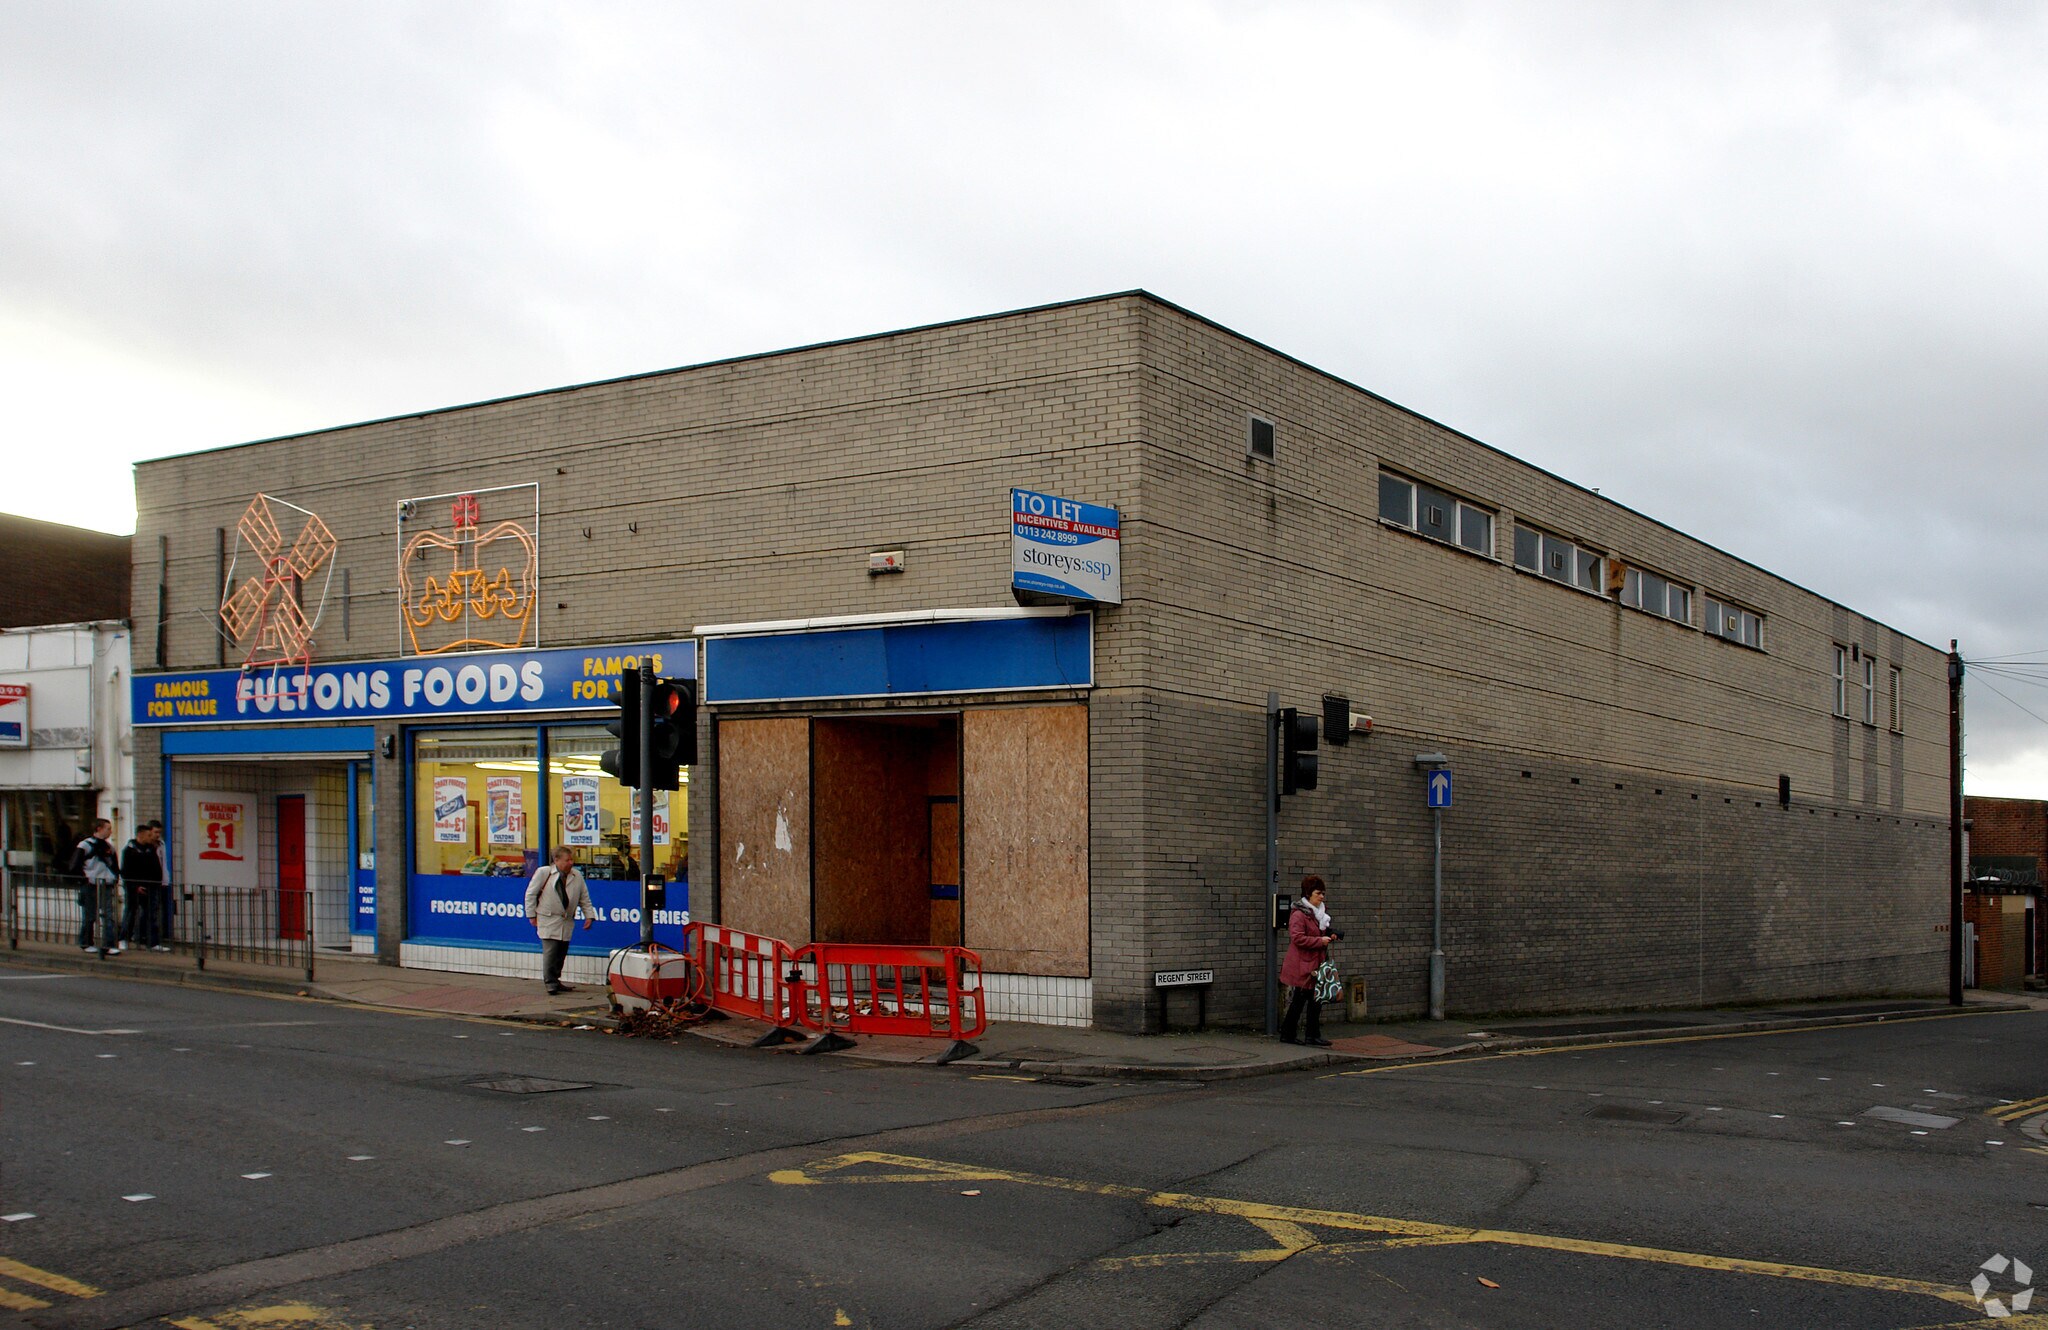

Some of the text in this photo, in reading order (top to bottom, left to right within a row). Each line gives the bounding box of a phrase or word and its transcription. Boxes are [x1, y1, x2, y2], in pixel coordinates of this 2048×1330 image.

[1018, 493, 1082, 523] TO LET
[1016, 513, 1117, 538] INCENTIVES AVAILABLE
[1018, 525, 1078, 544] 0113 242 8999
[1023, 548, 1111, 580] storeys:ssp
[154, 680, 209, 698] FAMOUS
[237, 660, 544, 714] FULTONS FOODS
[572, 679, 609, 700] FOR
[147, 699, 218, 717] FOR VALUE
[455, 817, 466, 832] £1
[508, 816, 521, 832] £1
[584, 813, 599, 831] £1
[206, 822, 234, 849] £1
[362, 896, 374, 904] PAY
[430, 899, 524, 918] FROZEN FOODS
[610, 907, 691, 926] GROERIES
[1157, 972, 1211, 983] REGENT STREET
